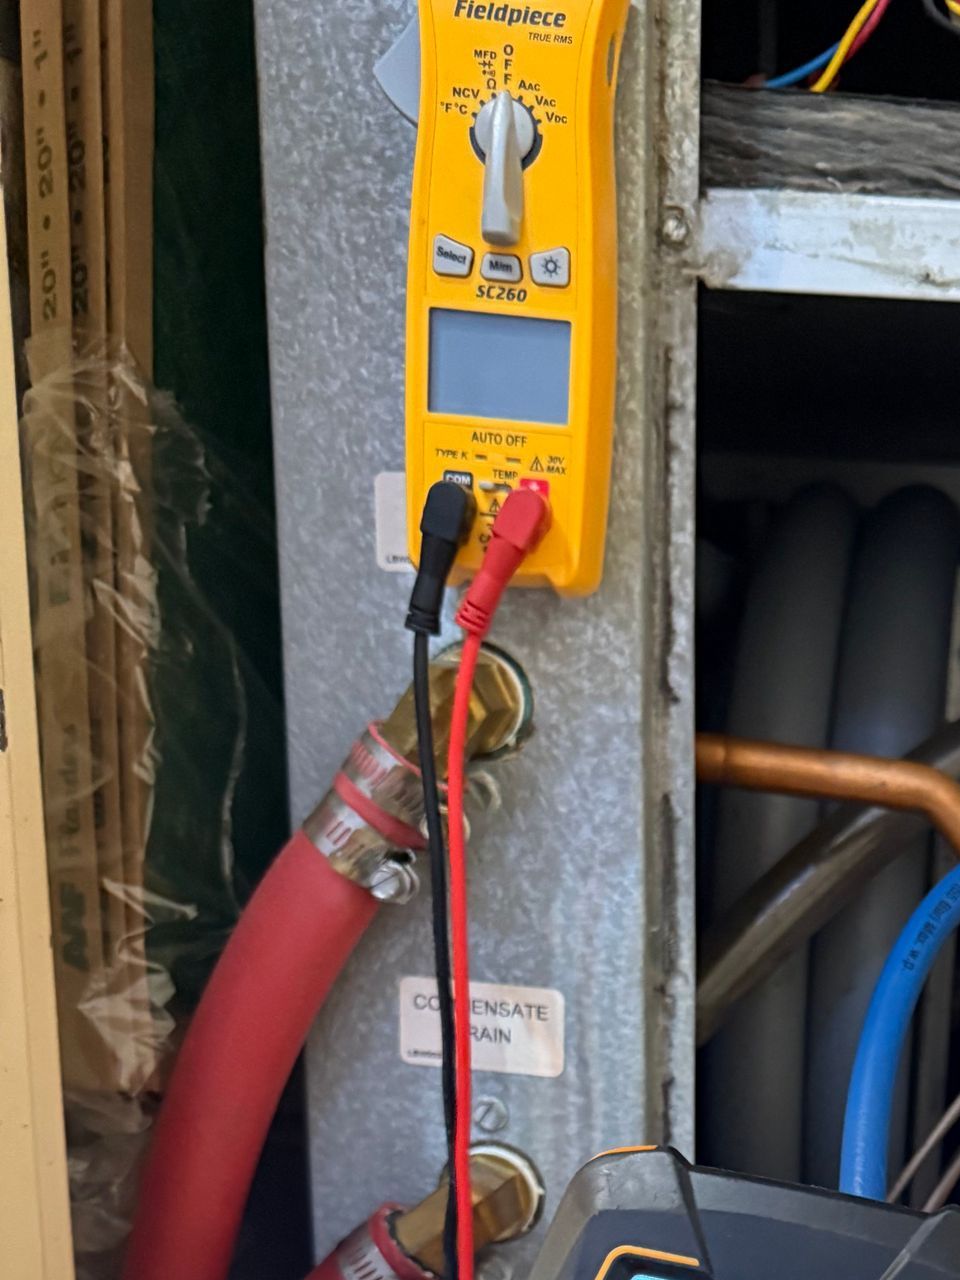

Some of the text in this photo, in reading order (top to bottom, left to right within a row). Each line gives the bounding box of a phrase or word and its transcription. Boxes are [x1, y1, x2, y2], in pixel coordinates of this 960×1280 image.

[454, 0, 566, 27] Fieldpiece
[528, 31, 573, 45] TRUE RMS
[474, 49, 497, 60] MFD
[452, 86, 480, 99] NCV
[436, 245, 467, 265] Select
[475, 285, 528, 302] SC260
[471, 431, 528, 448] AUTO OFF
[435, 448, 468, 460] TYPE K
[492, 469, 518, 480] TEMP
[546, 466, 567, 475] MAX
[414, 994, 549, 1022] COENSATE
[469, 1026, 512, 1045] RAIN
